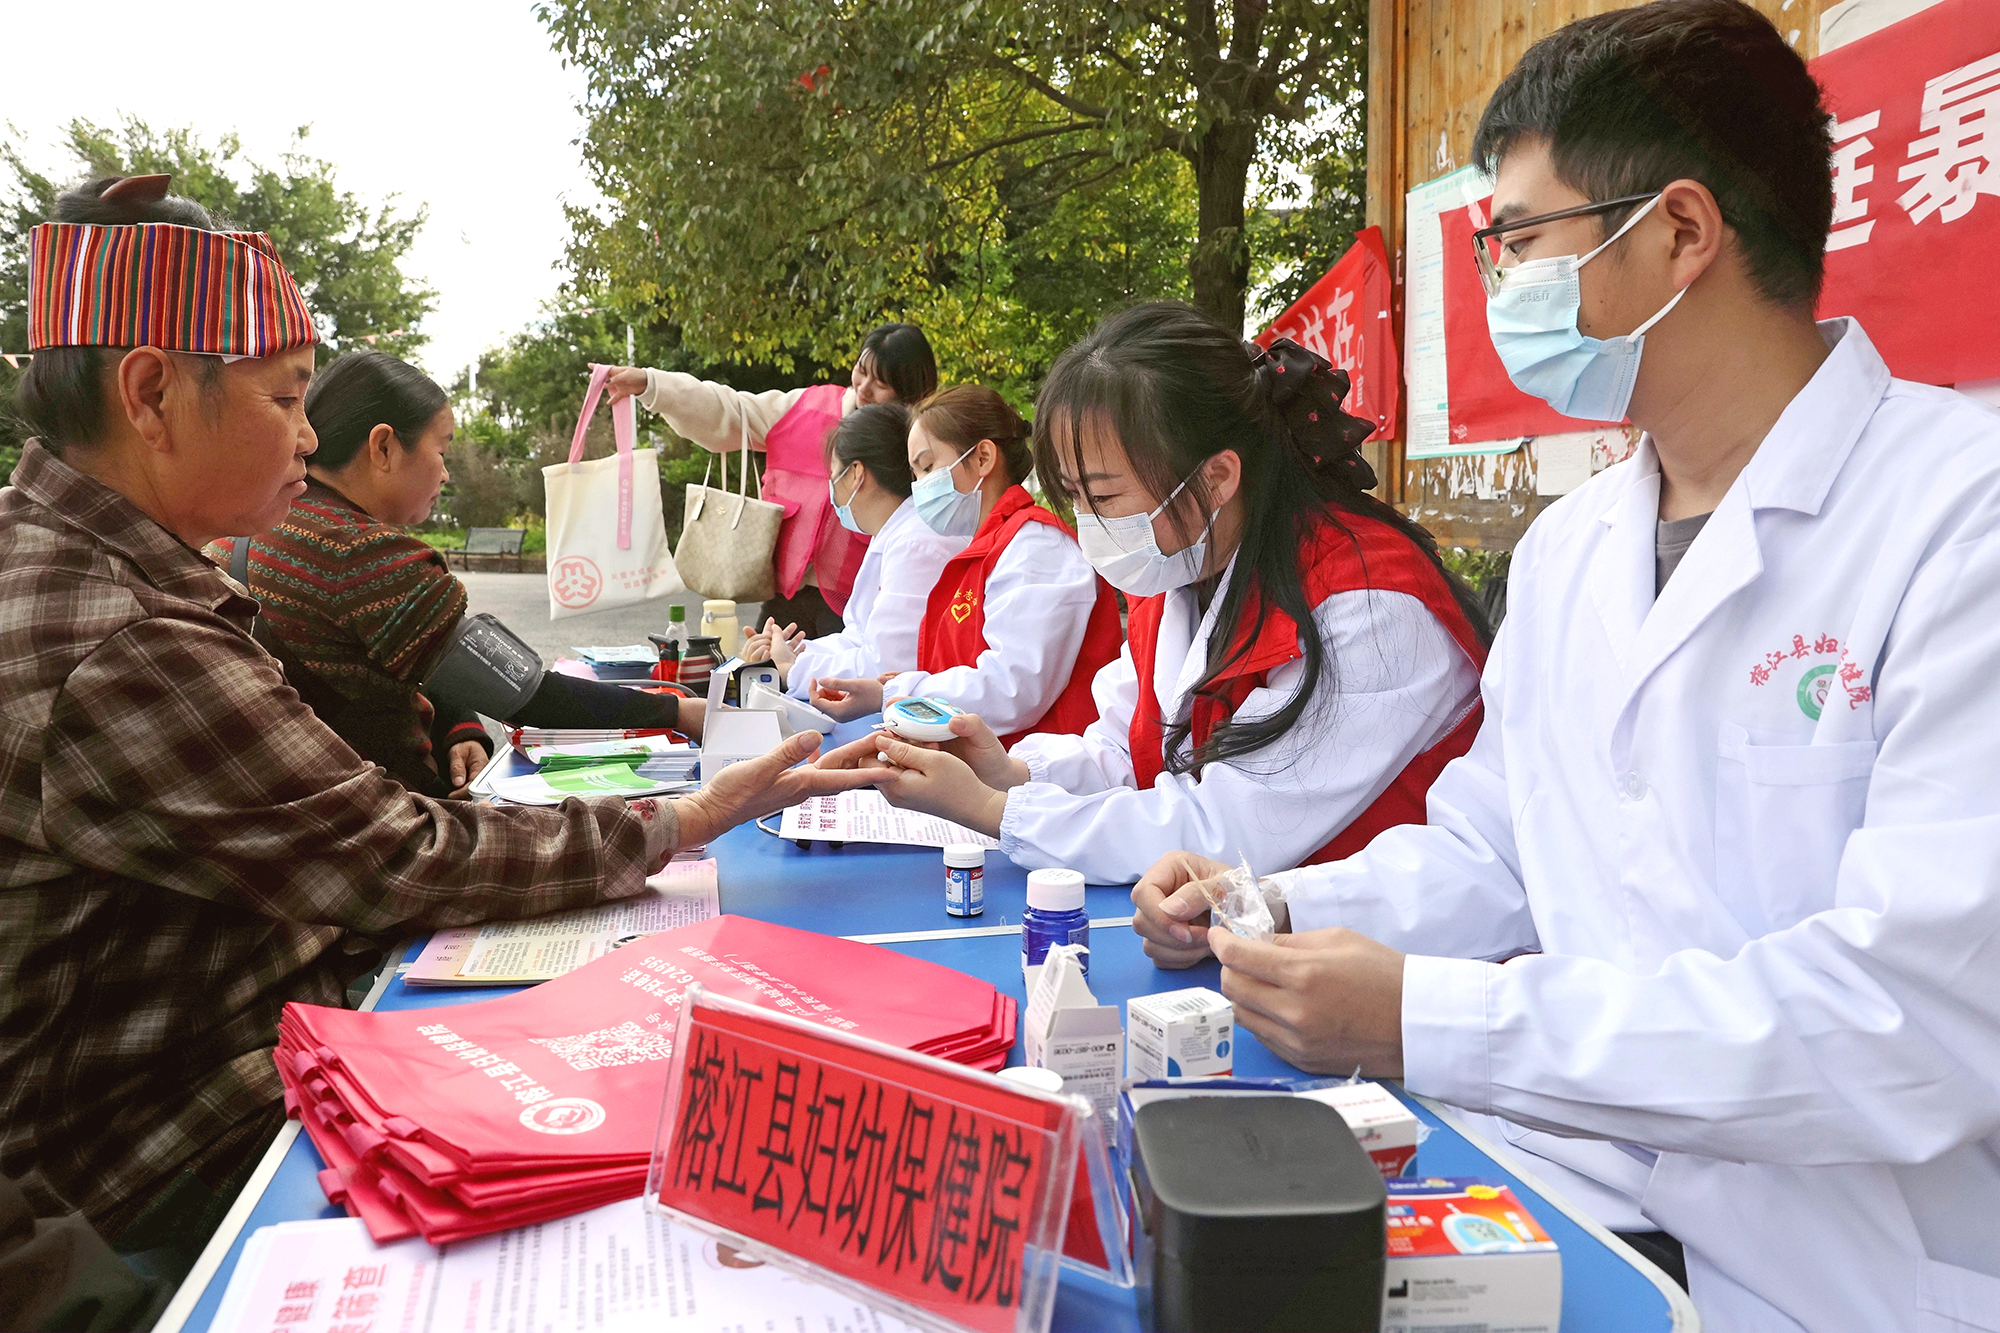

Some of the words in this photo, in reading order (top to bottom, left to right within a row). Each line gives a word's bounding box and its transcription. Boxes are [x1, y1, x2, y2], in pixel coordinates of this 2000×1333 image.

[619, 967, 686, 1011] 孕产妇电话：
[639, 956, 693, 989] 624995
[415, 1023, 554, 1105] 榕江县妇幼保健院
[673, 1031, 1032, 1309] 榕江县妇幼保健院
